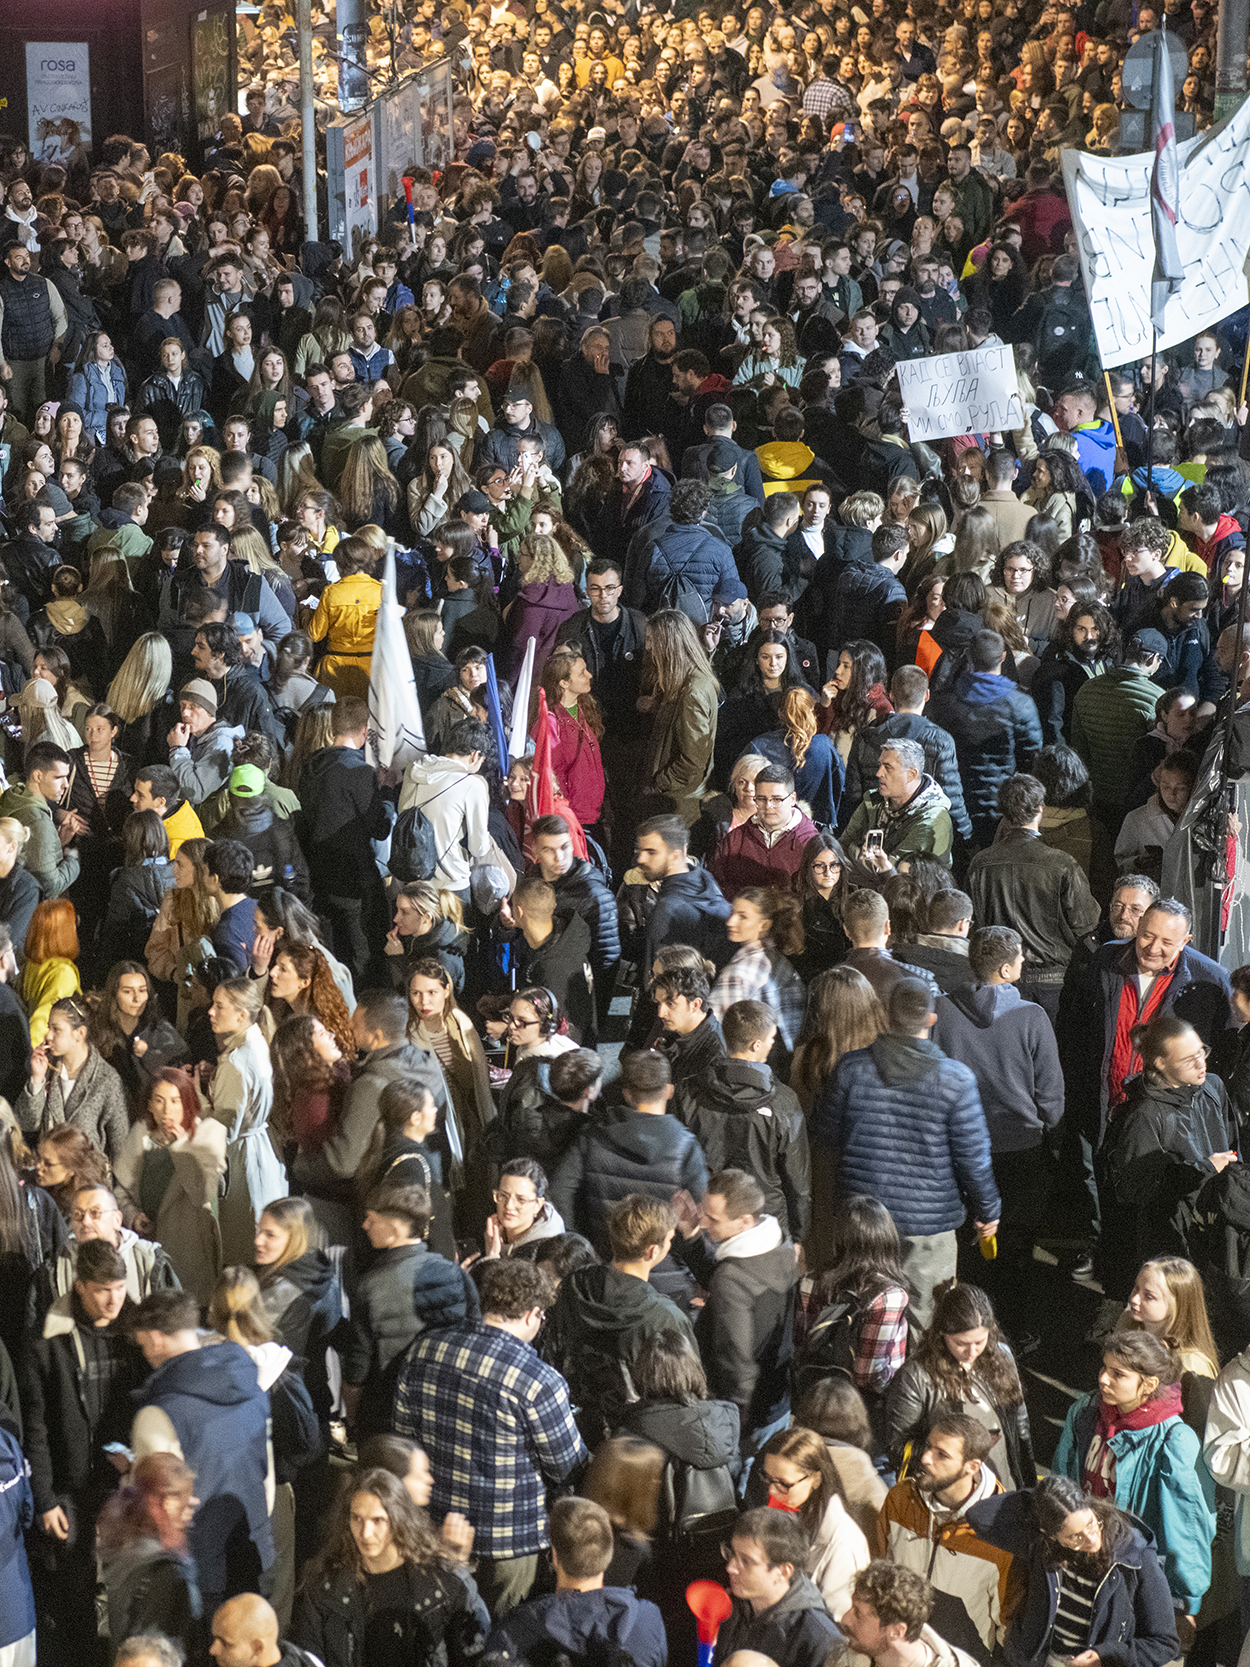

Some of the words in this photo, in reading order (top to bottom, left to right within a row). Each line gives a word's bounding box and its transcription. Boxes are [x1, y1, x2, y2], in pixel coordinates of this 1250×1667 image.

[40, 59, 76, 72] rosa
[899, 360, 932, 386] КАД
[935, 356, 953, 378] СЕ
[911, 416, 933, 434] МИ
[937, 411, 963, 431] СМО
